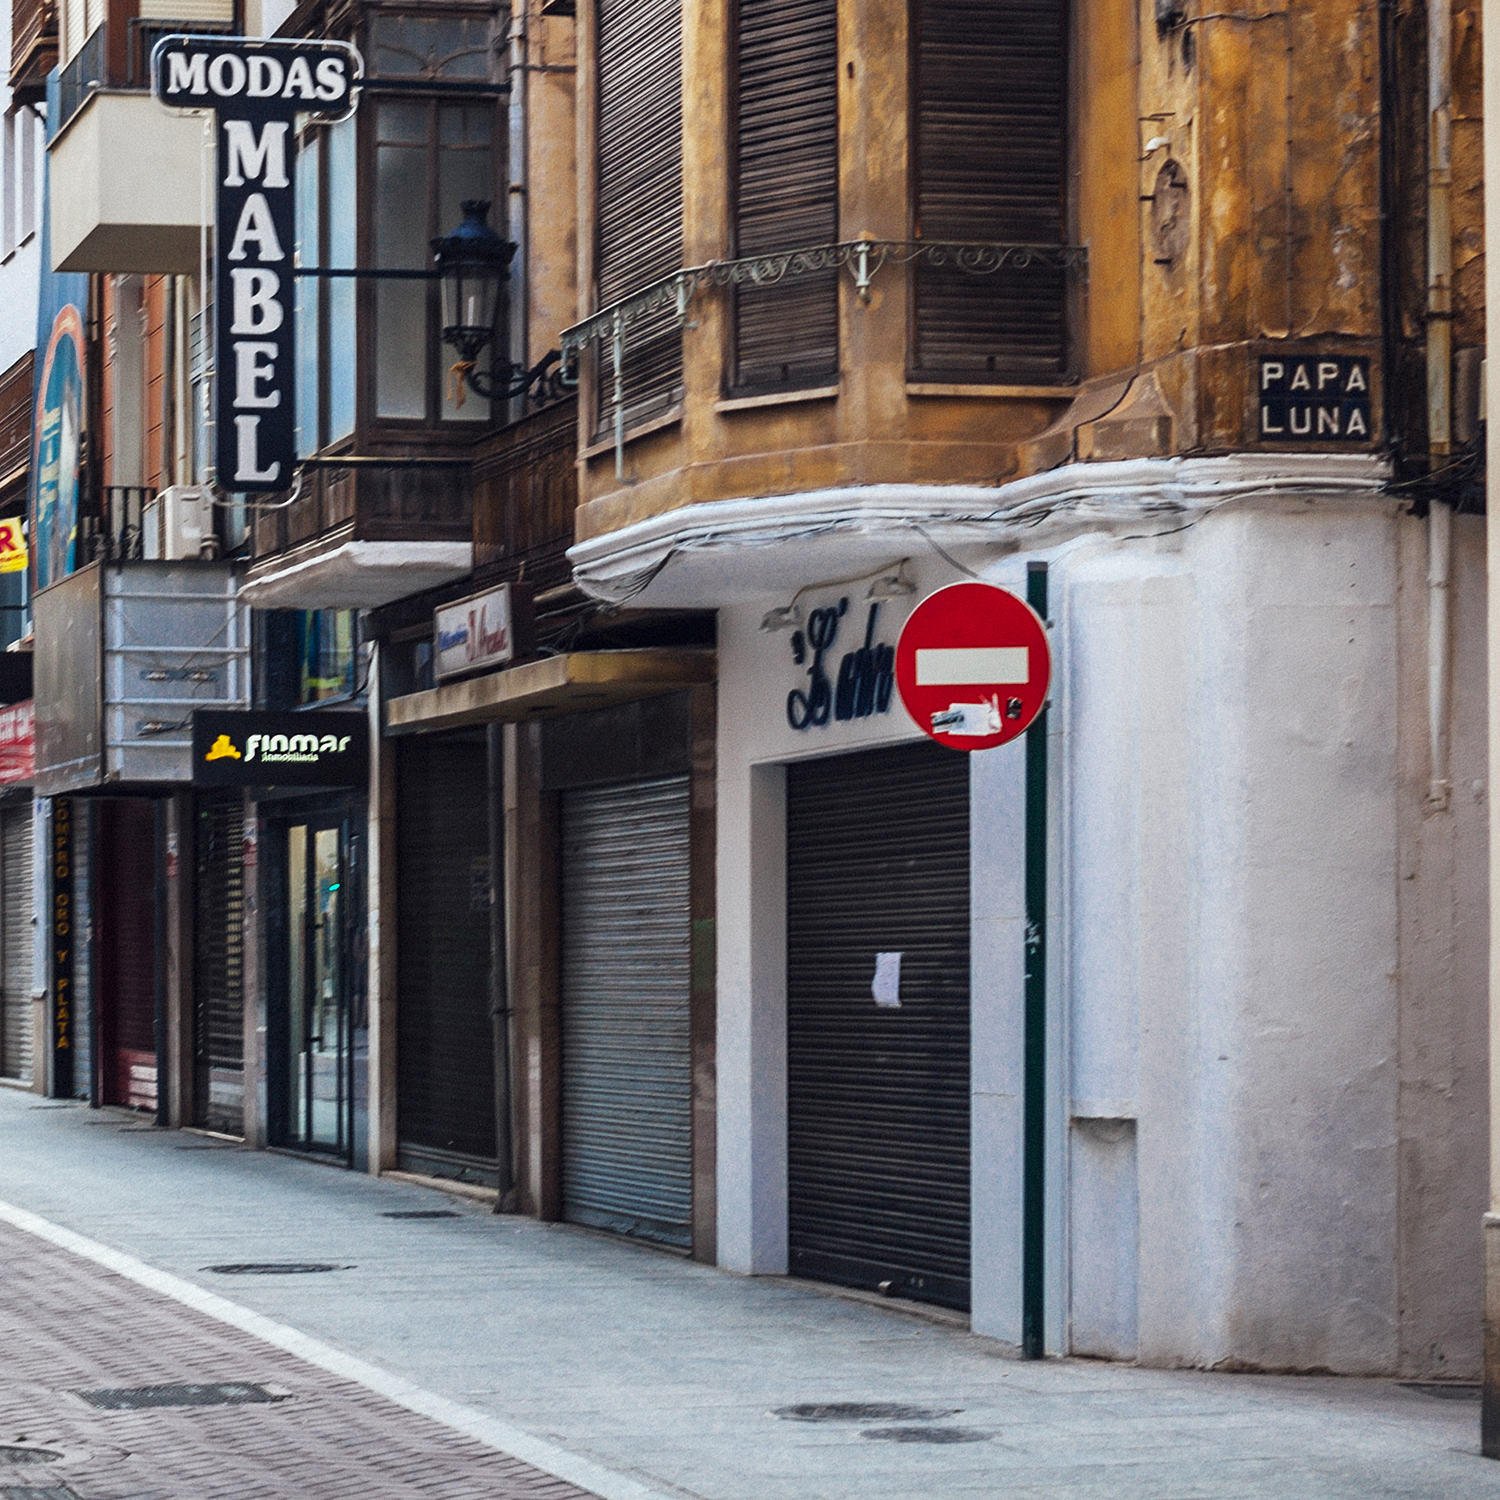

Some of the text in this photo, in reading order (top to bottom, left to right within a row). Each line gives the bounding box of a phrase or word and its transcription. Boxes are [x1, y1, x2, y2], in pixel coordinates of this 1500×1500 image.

[166, 51, 348, 100] MODAS
[223, 120, 290, 483] MABEL
[1261, 361, 1367, 392] PAPA
[1261, 406, 1367, 436] LUNA
